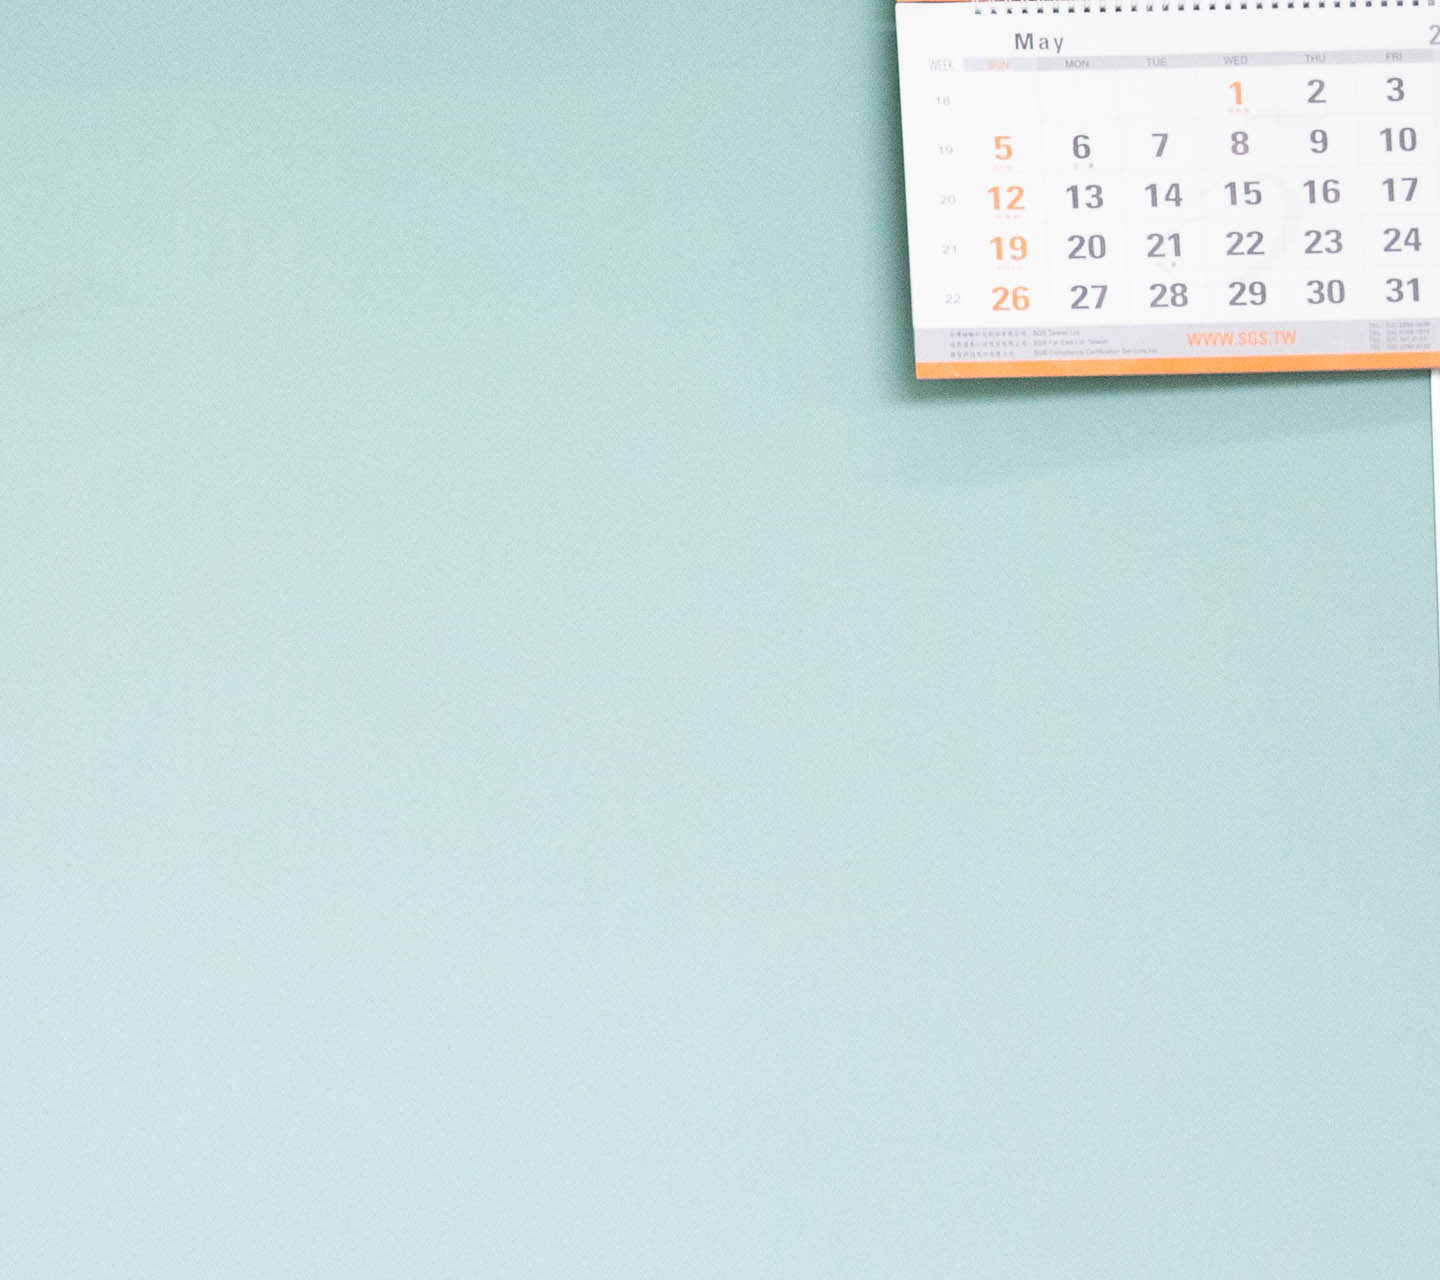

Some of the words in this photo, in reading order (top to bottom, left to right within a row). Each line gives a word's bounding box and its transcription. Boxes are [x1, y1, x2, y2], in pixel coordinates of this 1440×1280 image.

[1015, 33, 1063, 53] May
[988, 186, 1024, 210] 12
[1067, 185, 1103, 208] 13
[1145, 183, 1182, 207] 14
[1225, 181, 1261, 205] 15
[1304, 179, 1340, 203] 16
[1383, 178, 1417, 201] 17
[1184, 328, 1296, 349] WWW.SGS.TW
